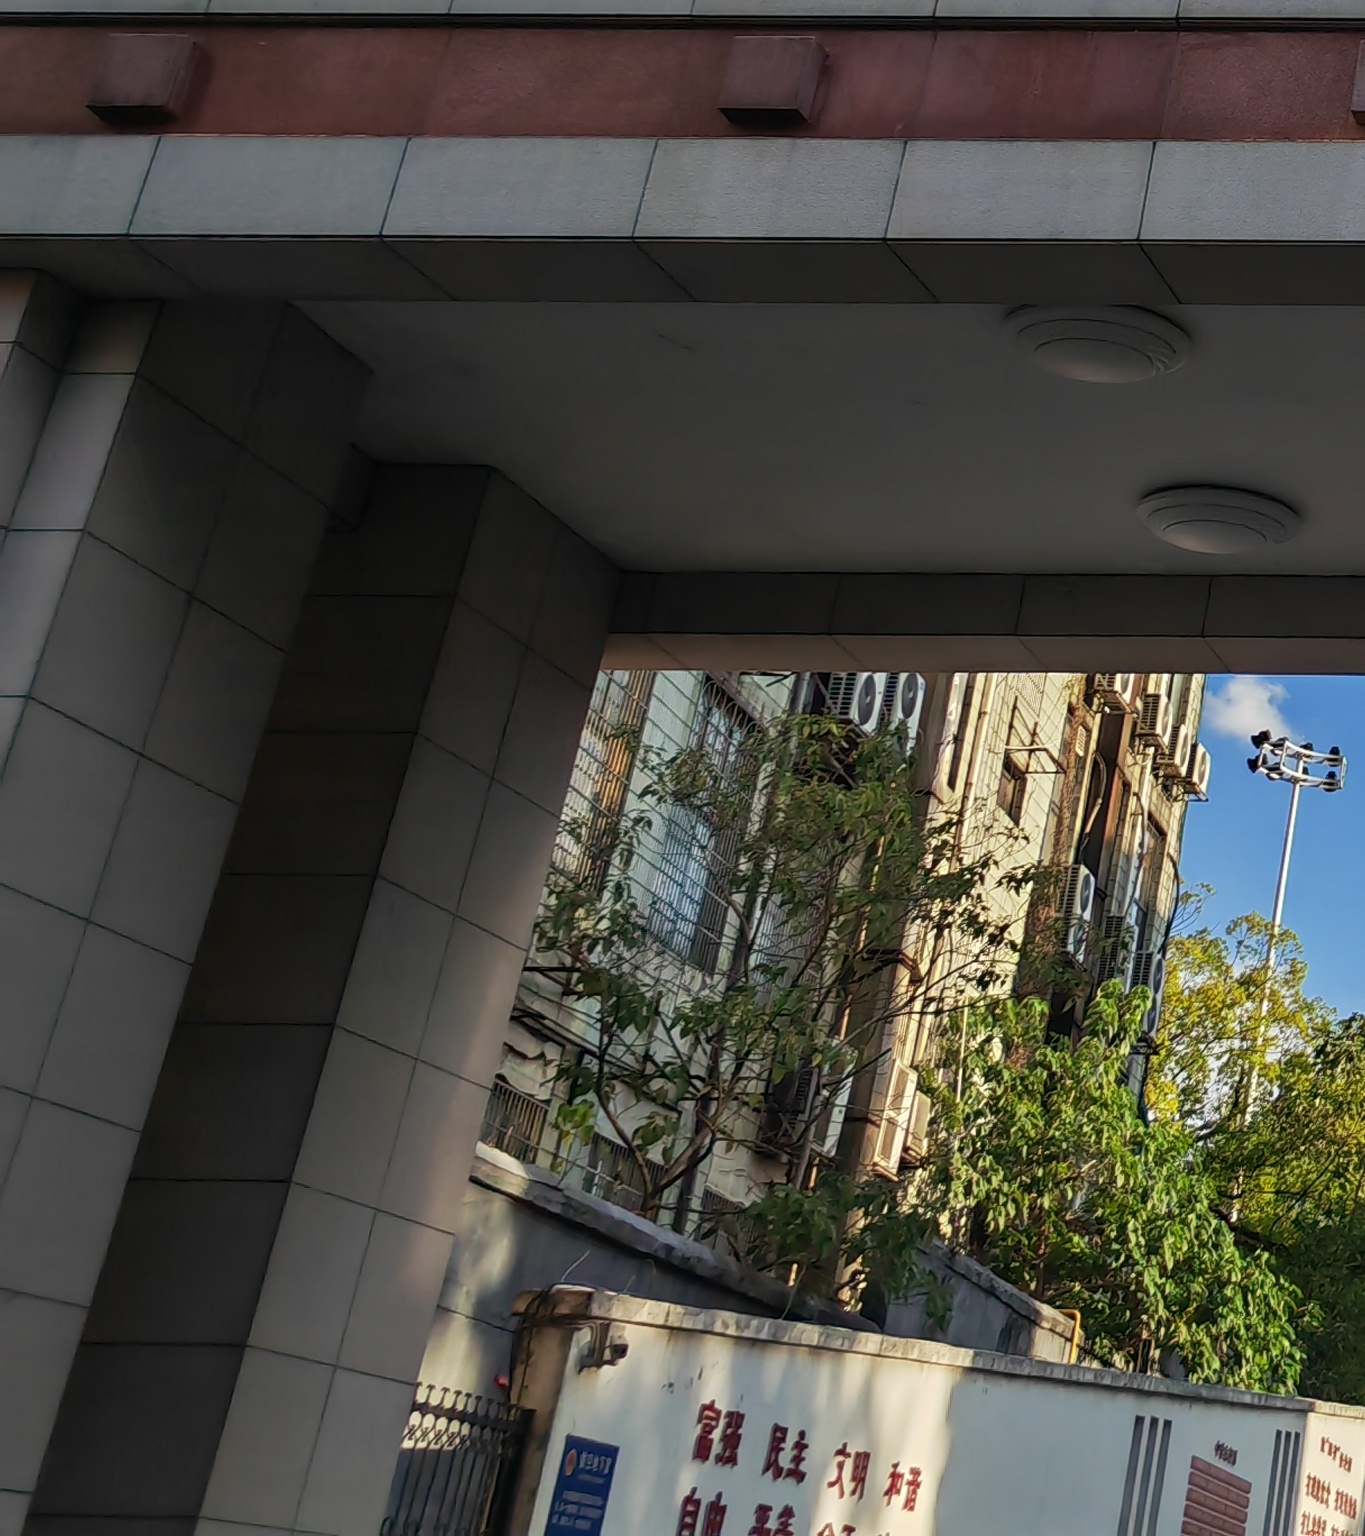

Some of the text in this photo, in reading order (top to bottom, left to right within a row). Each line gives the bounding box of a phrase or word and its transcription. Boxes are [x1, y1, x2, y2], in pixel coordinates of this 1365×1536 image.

[691, 1398, 922, 1512] 富强 民主 文明 和谐
[675, 1486, 728, 1536] 自由
